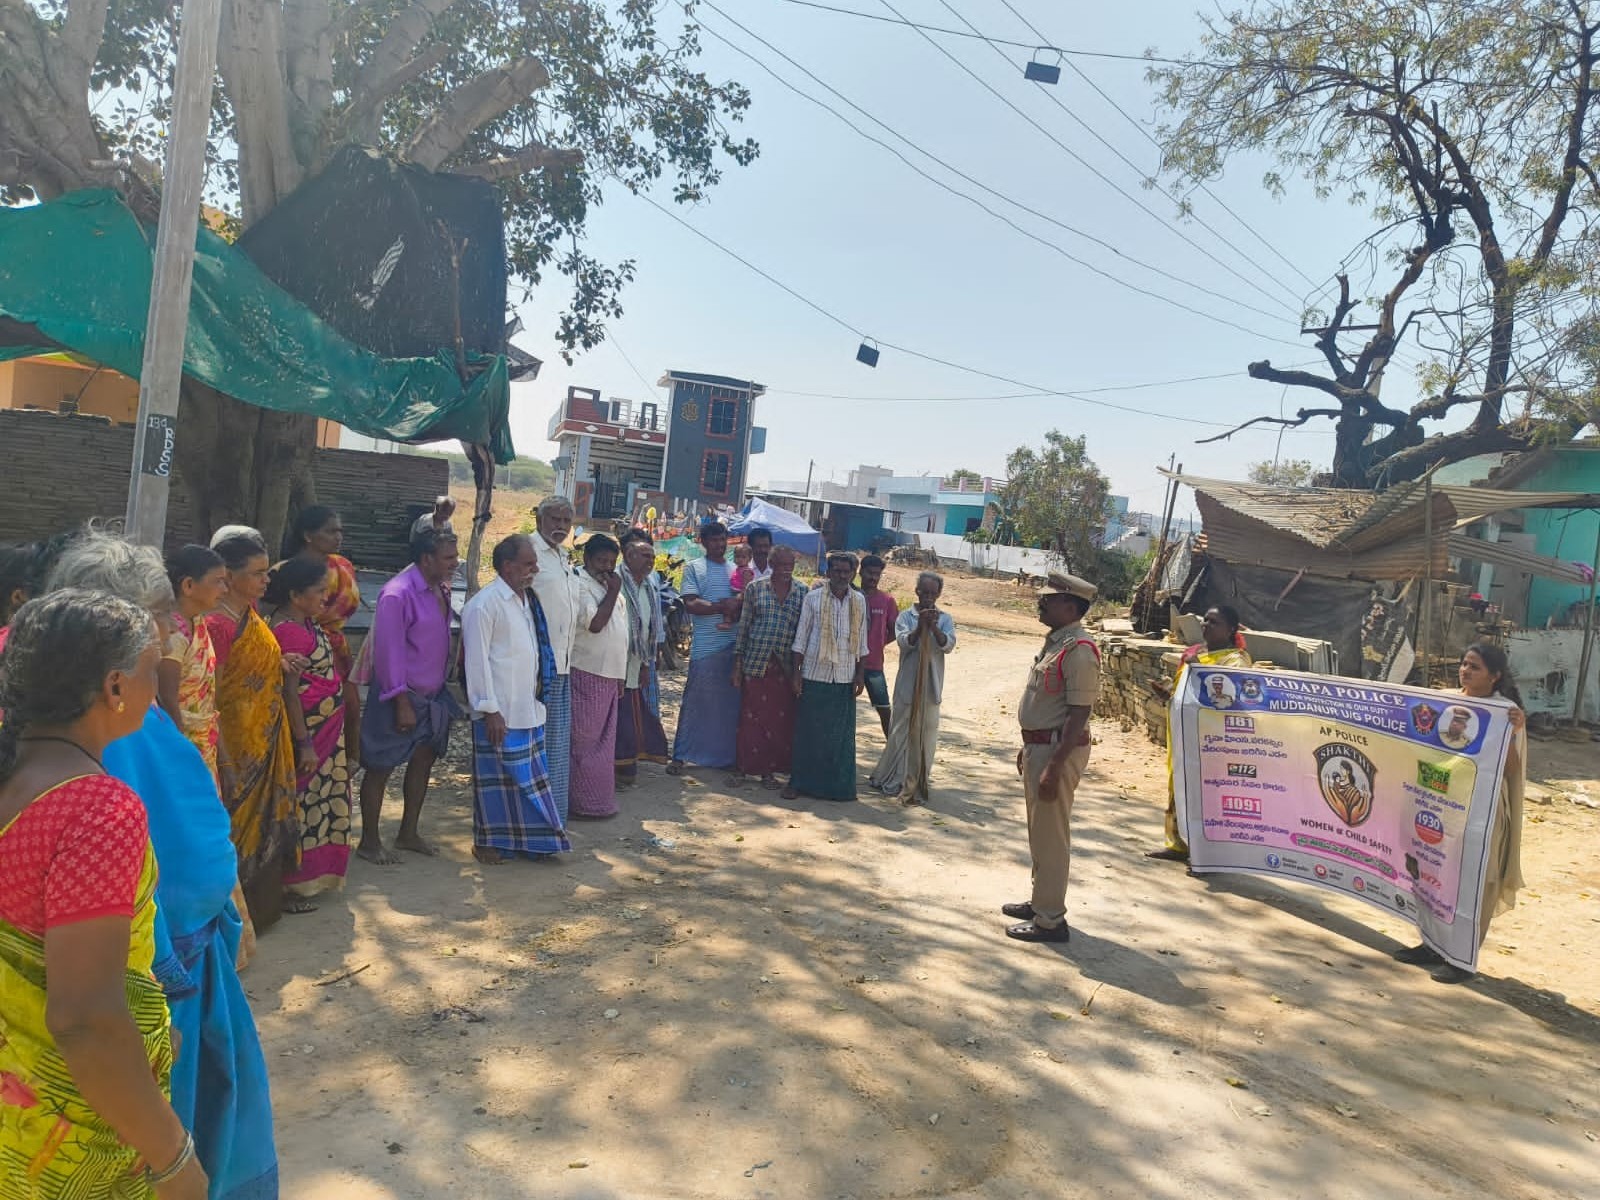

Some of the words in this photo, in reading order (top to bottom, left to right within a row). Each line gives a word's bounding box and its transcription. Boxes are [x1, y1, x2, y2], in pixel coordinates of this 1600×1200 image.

[1263, 677, 1332, 697] KADAPA
[1334, 686, 1407, 707] POLICE
[1228, 716, 1254, 729] 181
[1269, 699, 1339, 715] MUDDANUR
[1340, 709, 1362, 722] U/G
[1364, 712, 1407, 733] POLICE
[1319, 726, 1333, 738] AP
[1335, 730, 1369, 747] POLICE
[1237, 765, 1256, 775] 112
[1225, 797, 1261, 813] 1091
[1417, 813, 1441, 830] 1930
[1300, 818, 1334, 832] WOMEN
[1345, 829, 1367, 845] CHILD
[1369, 839, 1393, 856] SAFETY
